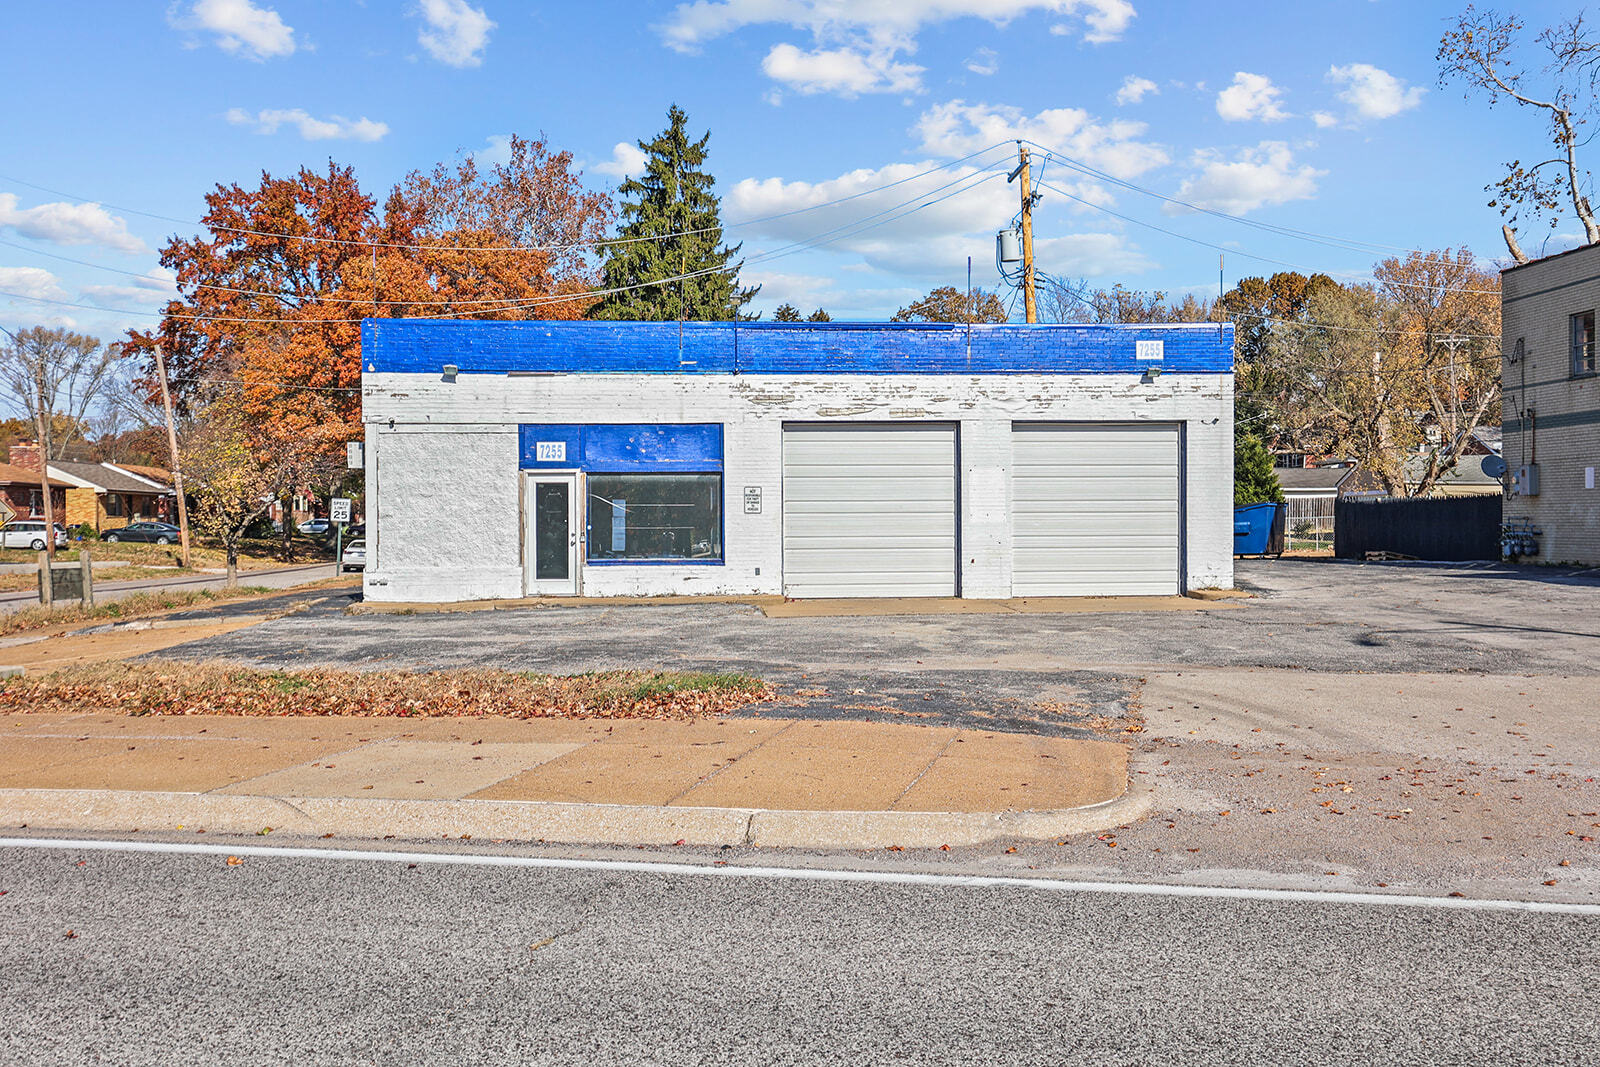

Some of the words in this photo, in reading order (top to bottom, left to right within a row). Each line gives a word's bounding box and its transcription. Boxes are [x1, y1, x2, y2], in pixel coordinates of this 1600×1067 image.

[1139, 343, 1161, 357] 7255
[540, 444, 563, 459] 7255
[333, 510, 348, 520] 25
